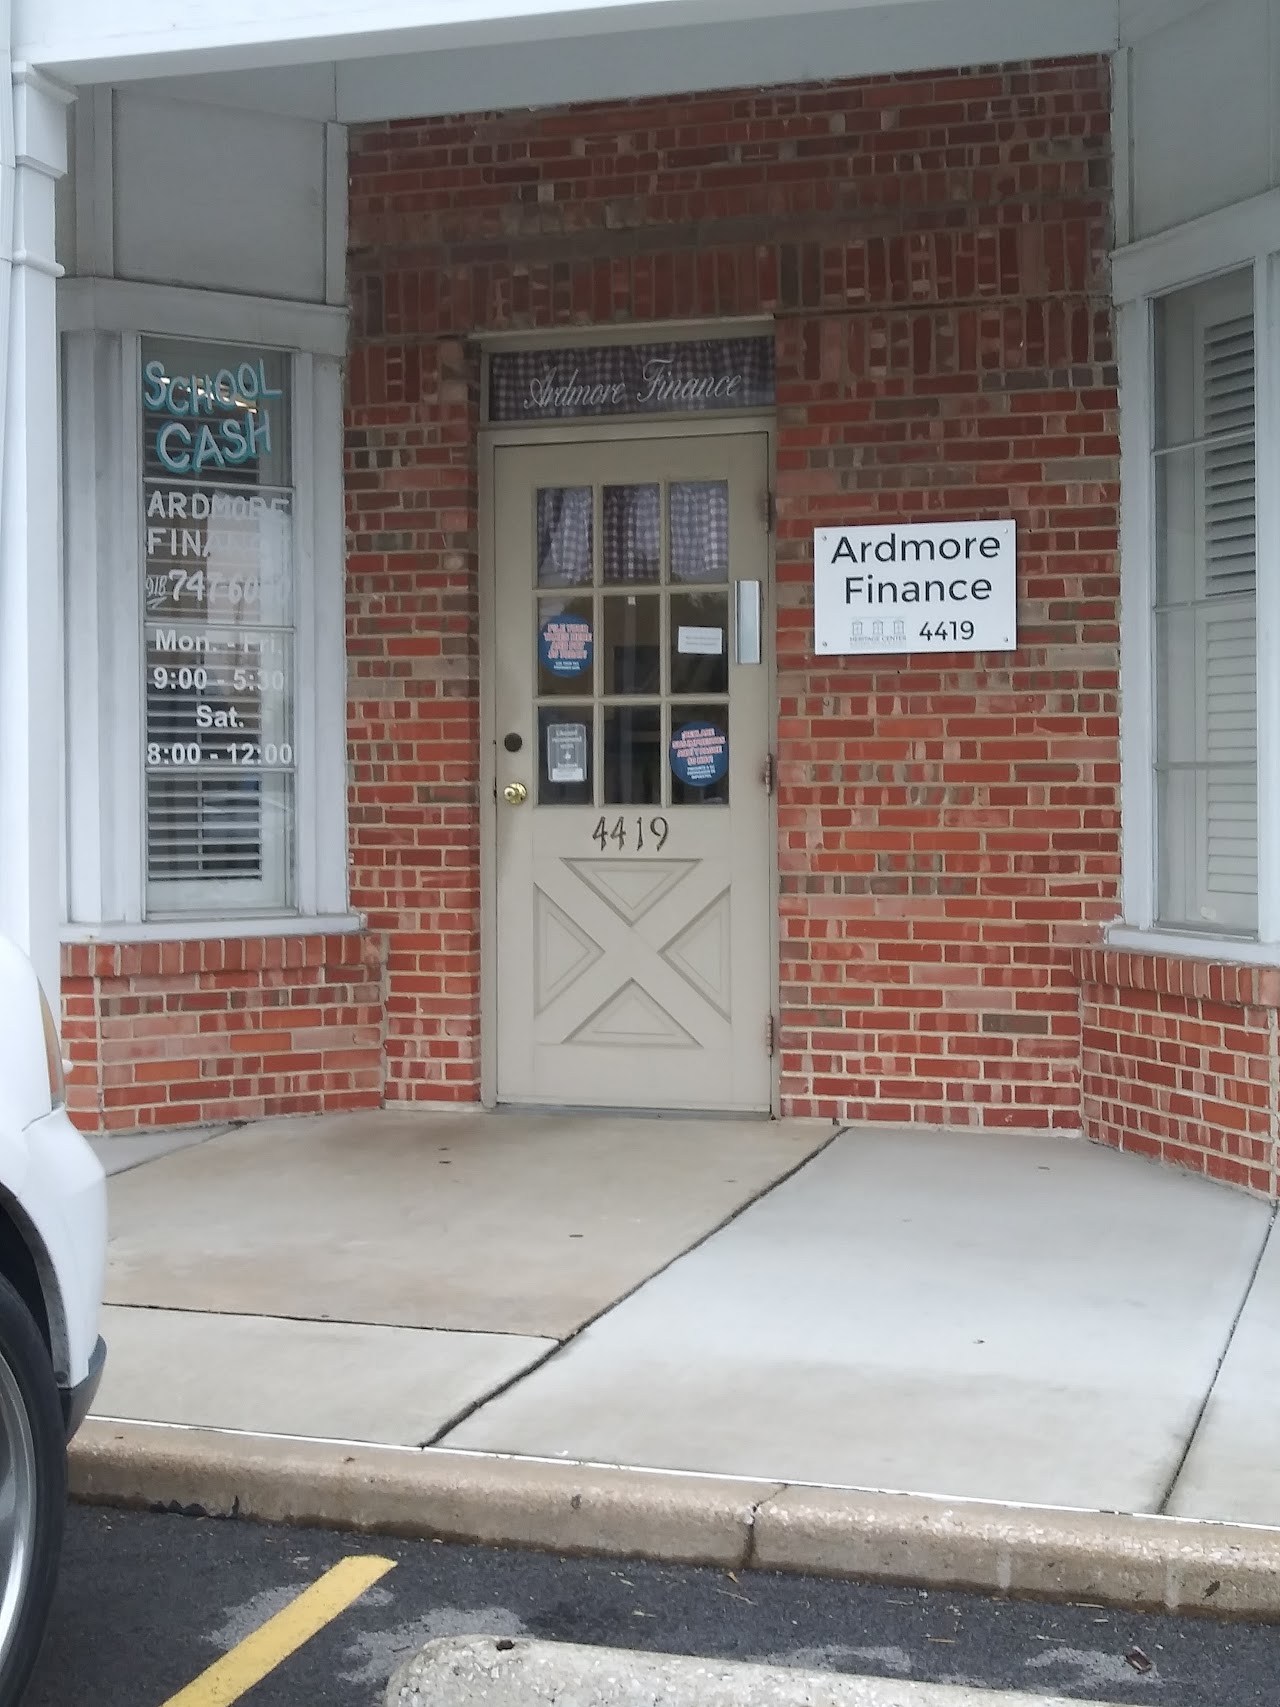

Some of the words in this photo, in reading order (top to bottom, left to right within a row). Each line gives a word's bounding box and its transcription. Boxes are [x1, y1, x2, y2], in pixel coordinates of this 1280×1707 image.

[144, 357, 283, 416] SCHOOL
[524, 368, 626, 410] Ardmore
[636, 358, 742, 402] Finance
[157, 409, 272, 474] CASH
[831, 532, 1001, 564] Ardmore
[845, 574, 992, 604] Finance
[156, 629, 217, 652] Mon.
[919, 620, 975, 641] 4419
[153, 667, 208, 690] 9:00
[233, 669, 284, 691] 5:30
[196, 705, 244, 728] Sat.
[147, 743, 201, 765] 8:00
[227, 743, 292, 765] 12:00
[592, 816, 669, 852] 4419
